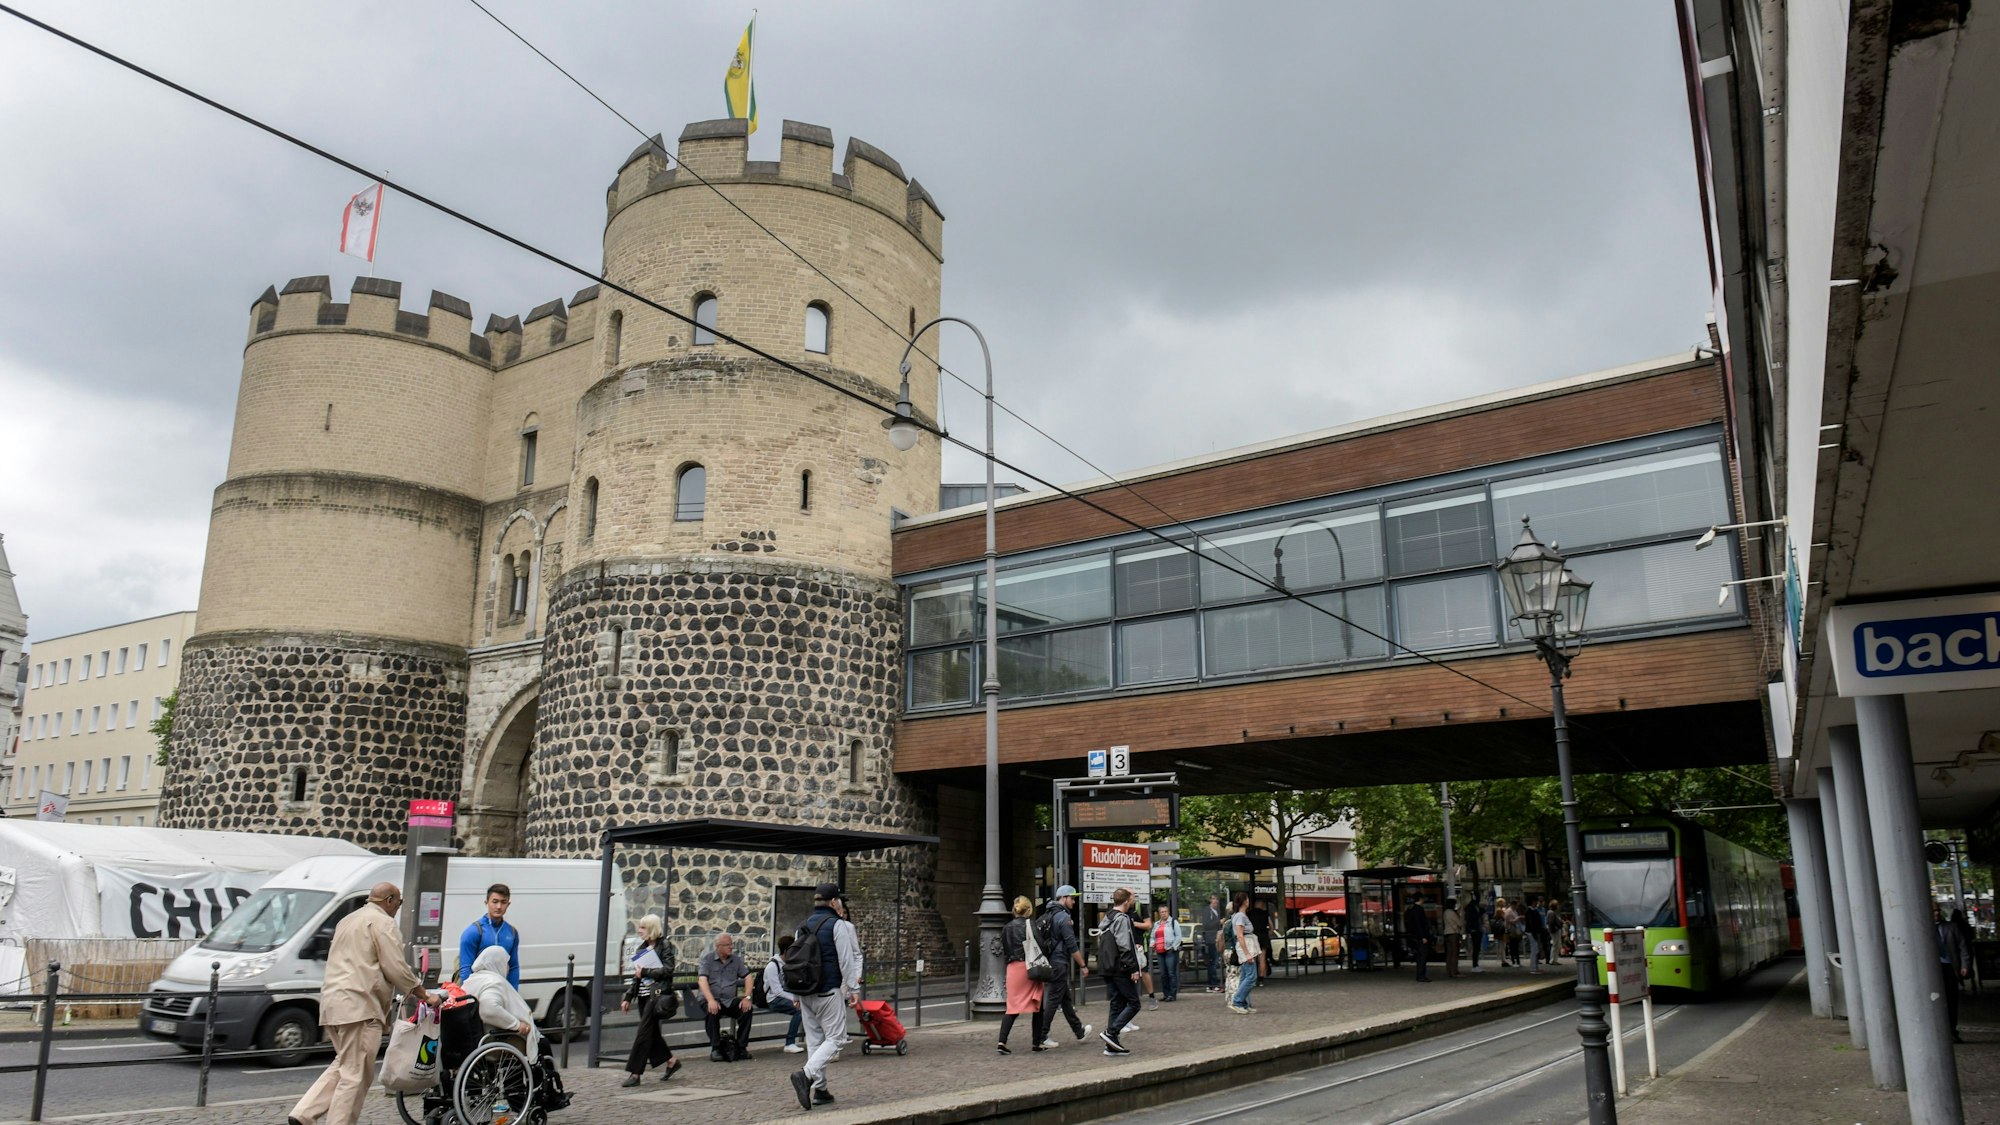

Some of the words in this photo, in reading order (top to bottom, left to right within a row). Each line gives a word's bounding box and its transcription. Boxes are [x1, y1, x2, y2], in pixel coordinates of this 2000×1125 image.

[1115, 753, 1125, 769] 3
[1091, 846, 1142, 868] Rudolfplatz
[1332, 876, 1345, 884] Jah
[1254, 885, 1278, 894] chmuck
[129, 882, 253, 939] CHI
